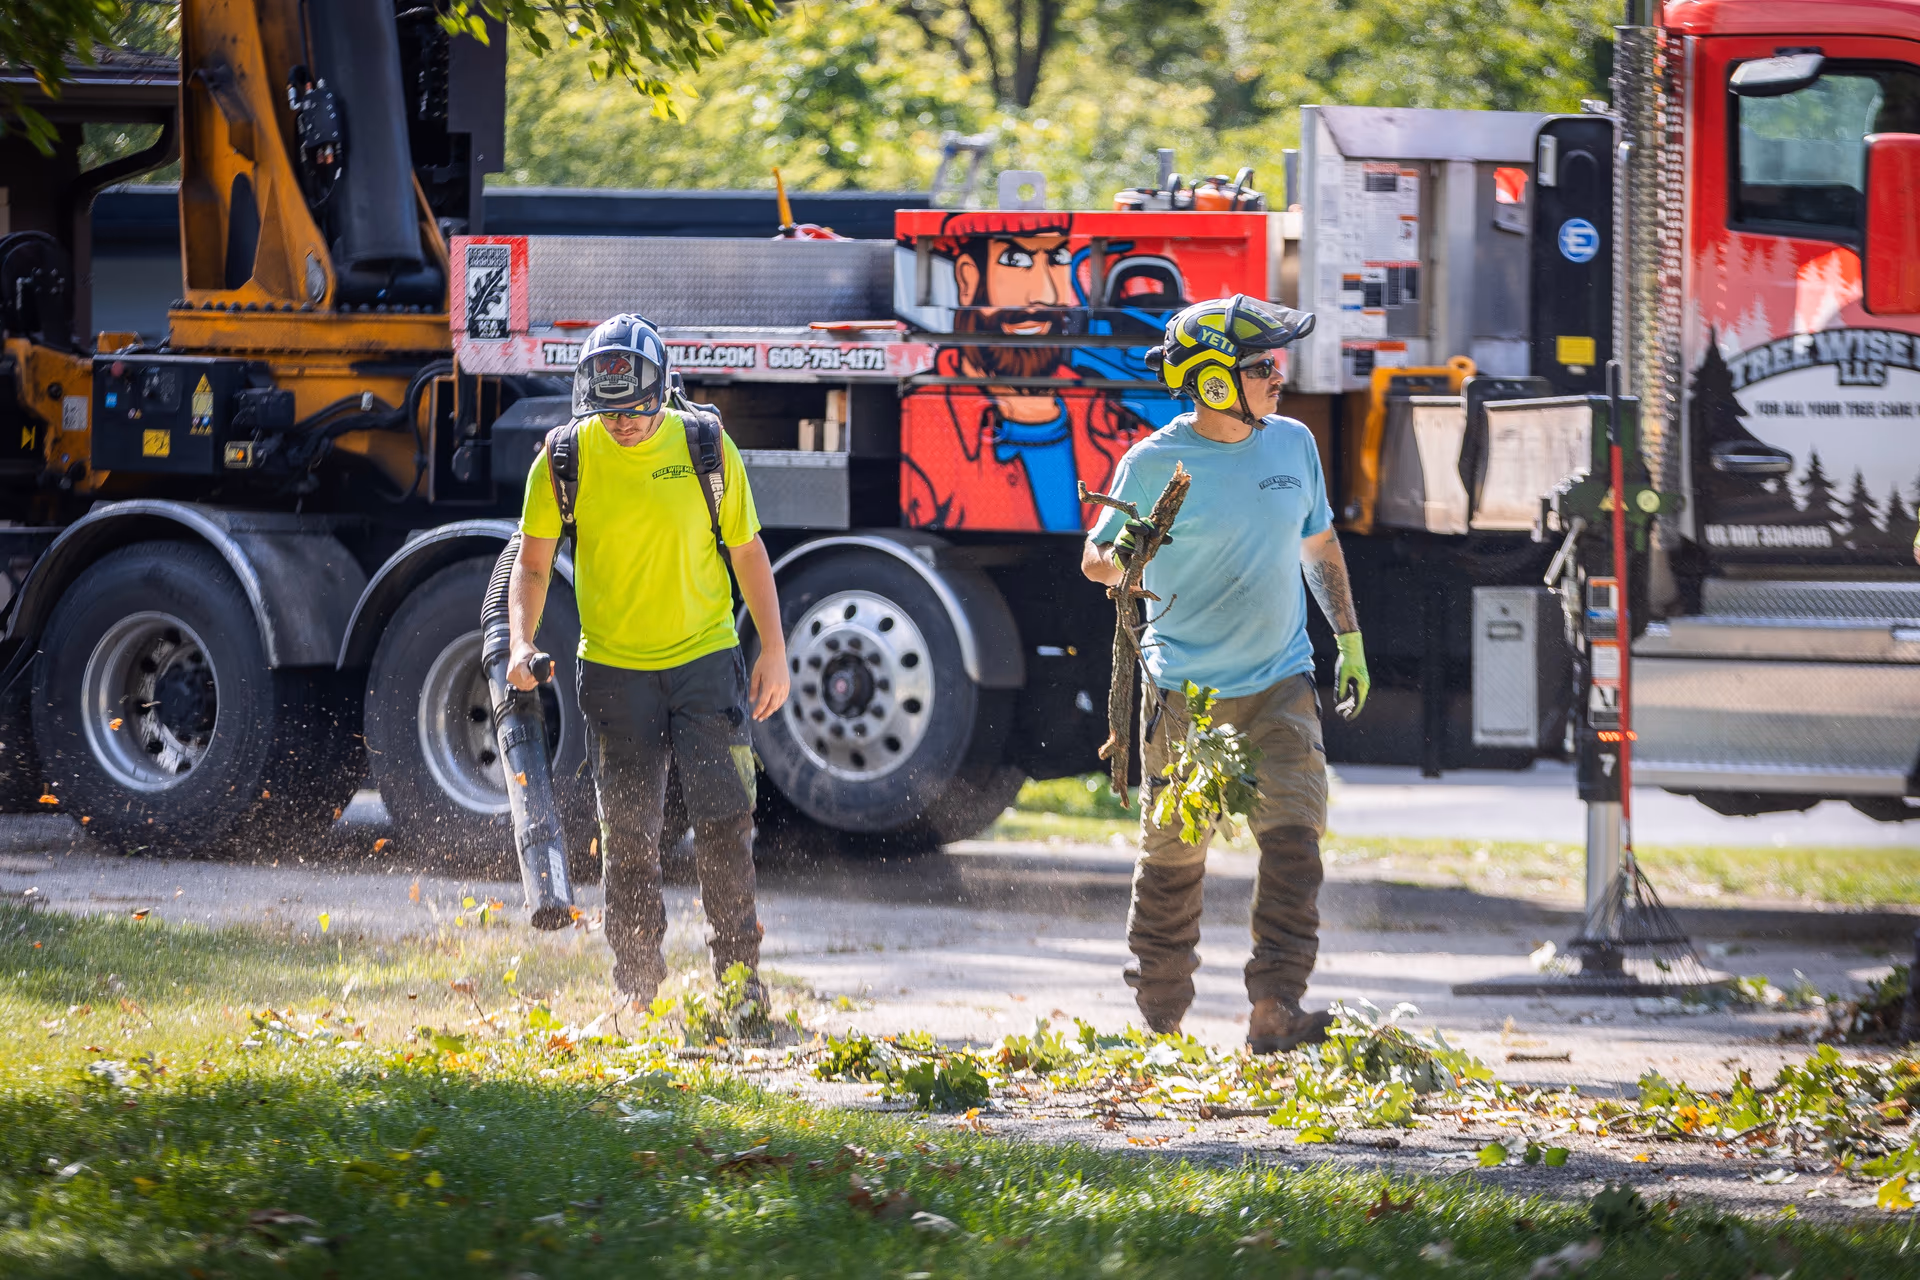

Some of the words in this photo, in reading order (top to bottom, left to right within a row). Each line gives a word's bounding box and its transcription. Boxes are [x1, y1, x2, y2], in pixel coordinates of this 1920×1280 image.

[1201, 328, 1235, 353] YETI
[768, 346, 885, 370] 608-751-4171
[1840, 361, 1886, 384] LLC
[1598, 753, 1616, 777] 7
